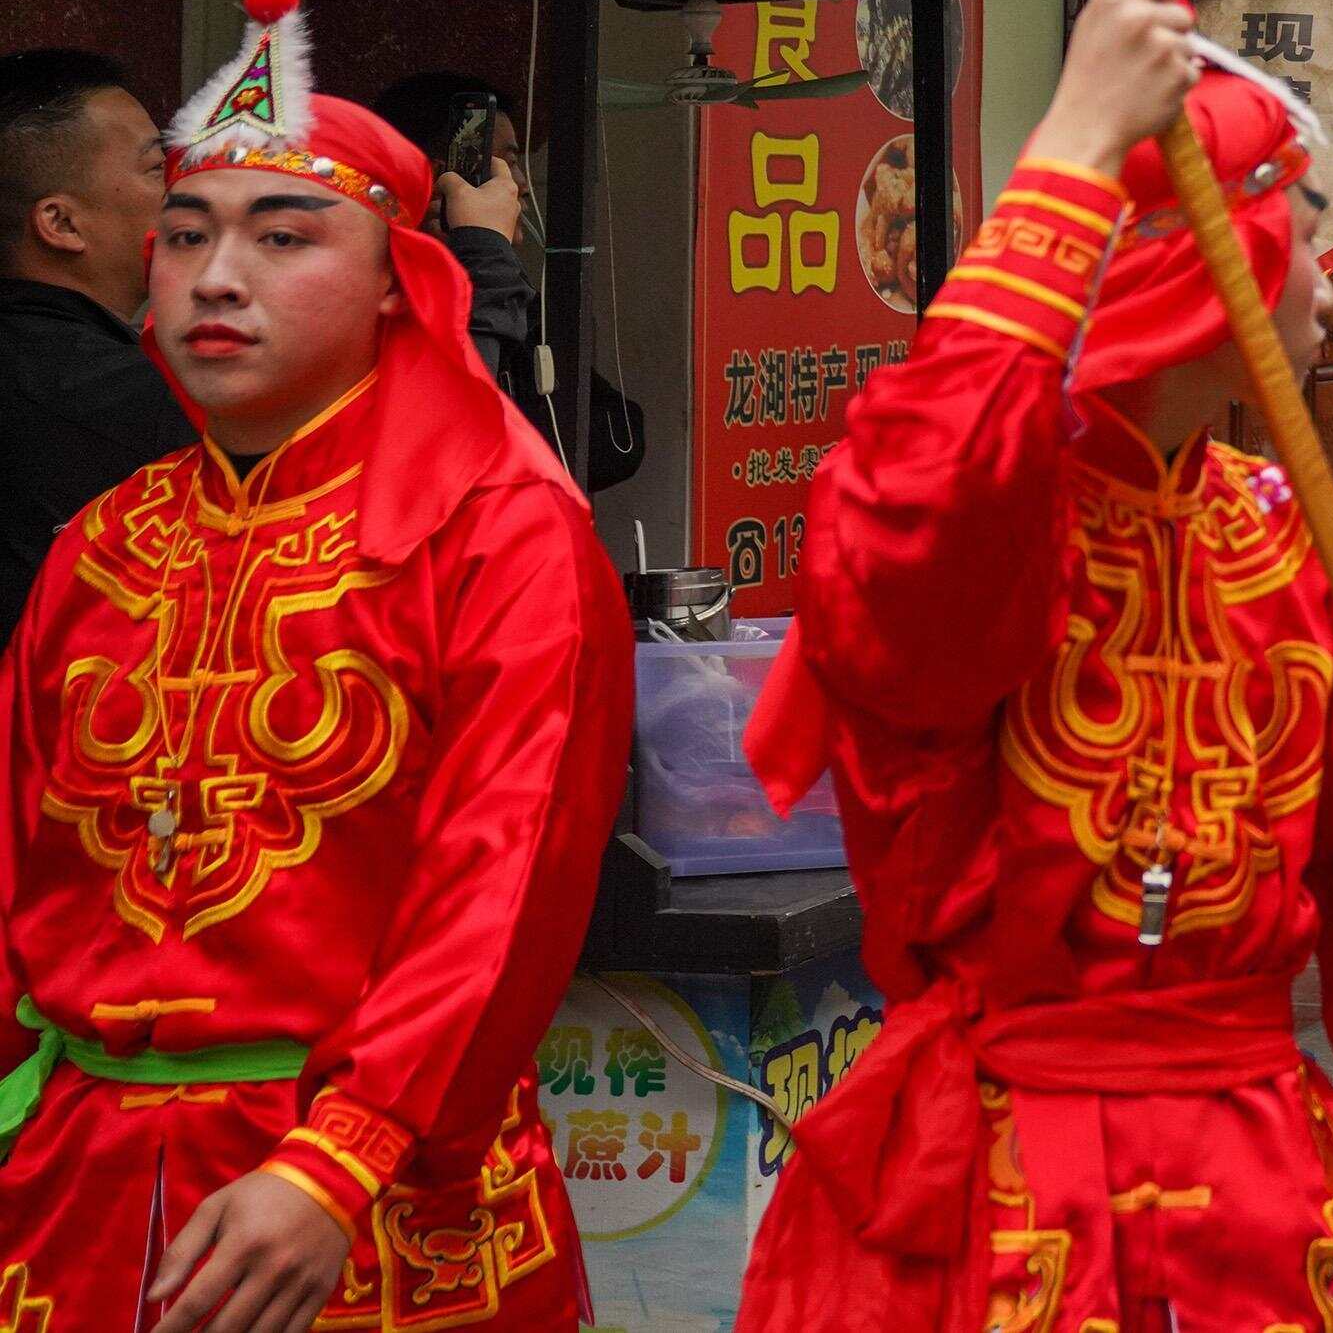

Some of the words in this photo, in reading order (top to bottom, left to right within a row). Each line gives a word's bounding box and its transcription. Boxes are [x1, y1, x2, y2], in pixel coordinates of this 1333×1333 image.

[725, 347, 847, 428] 龙湖特产
[746, 445, 838, 487] 批发零
[540, 1108, 701, 1183] 蔗汁
